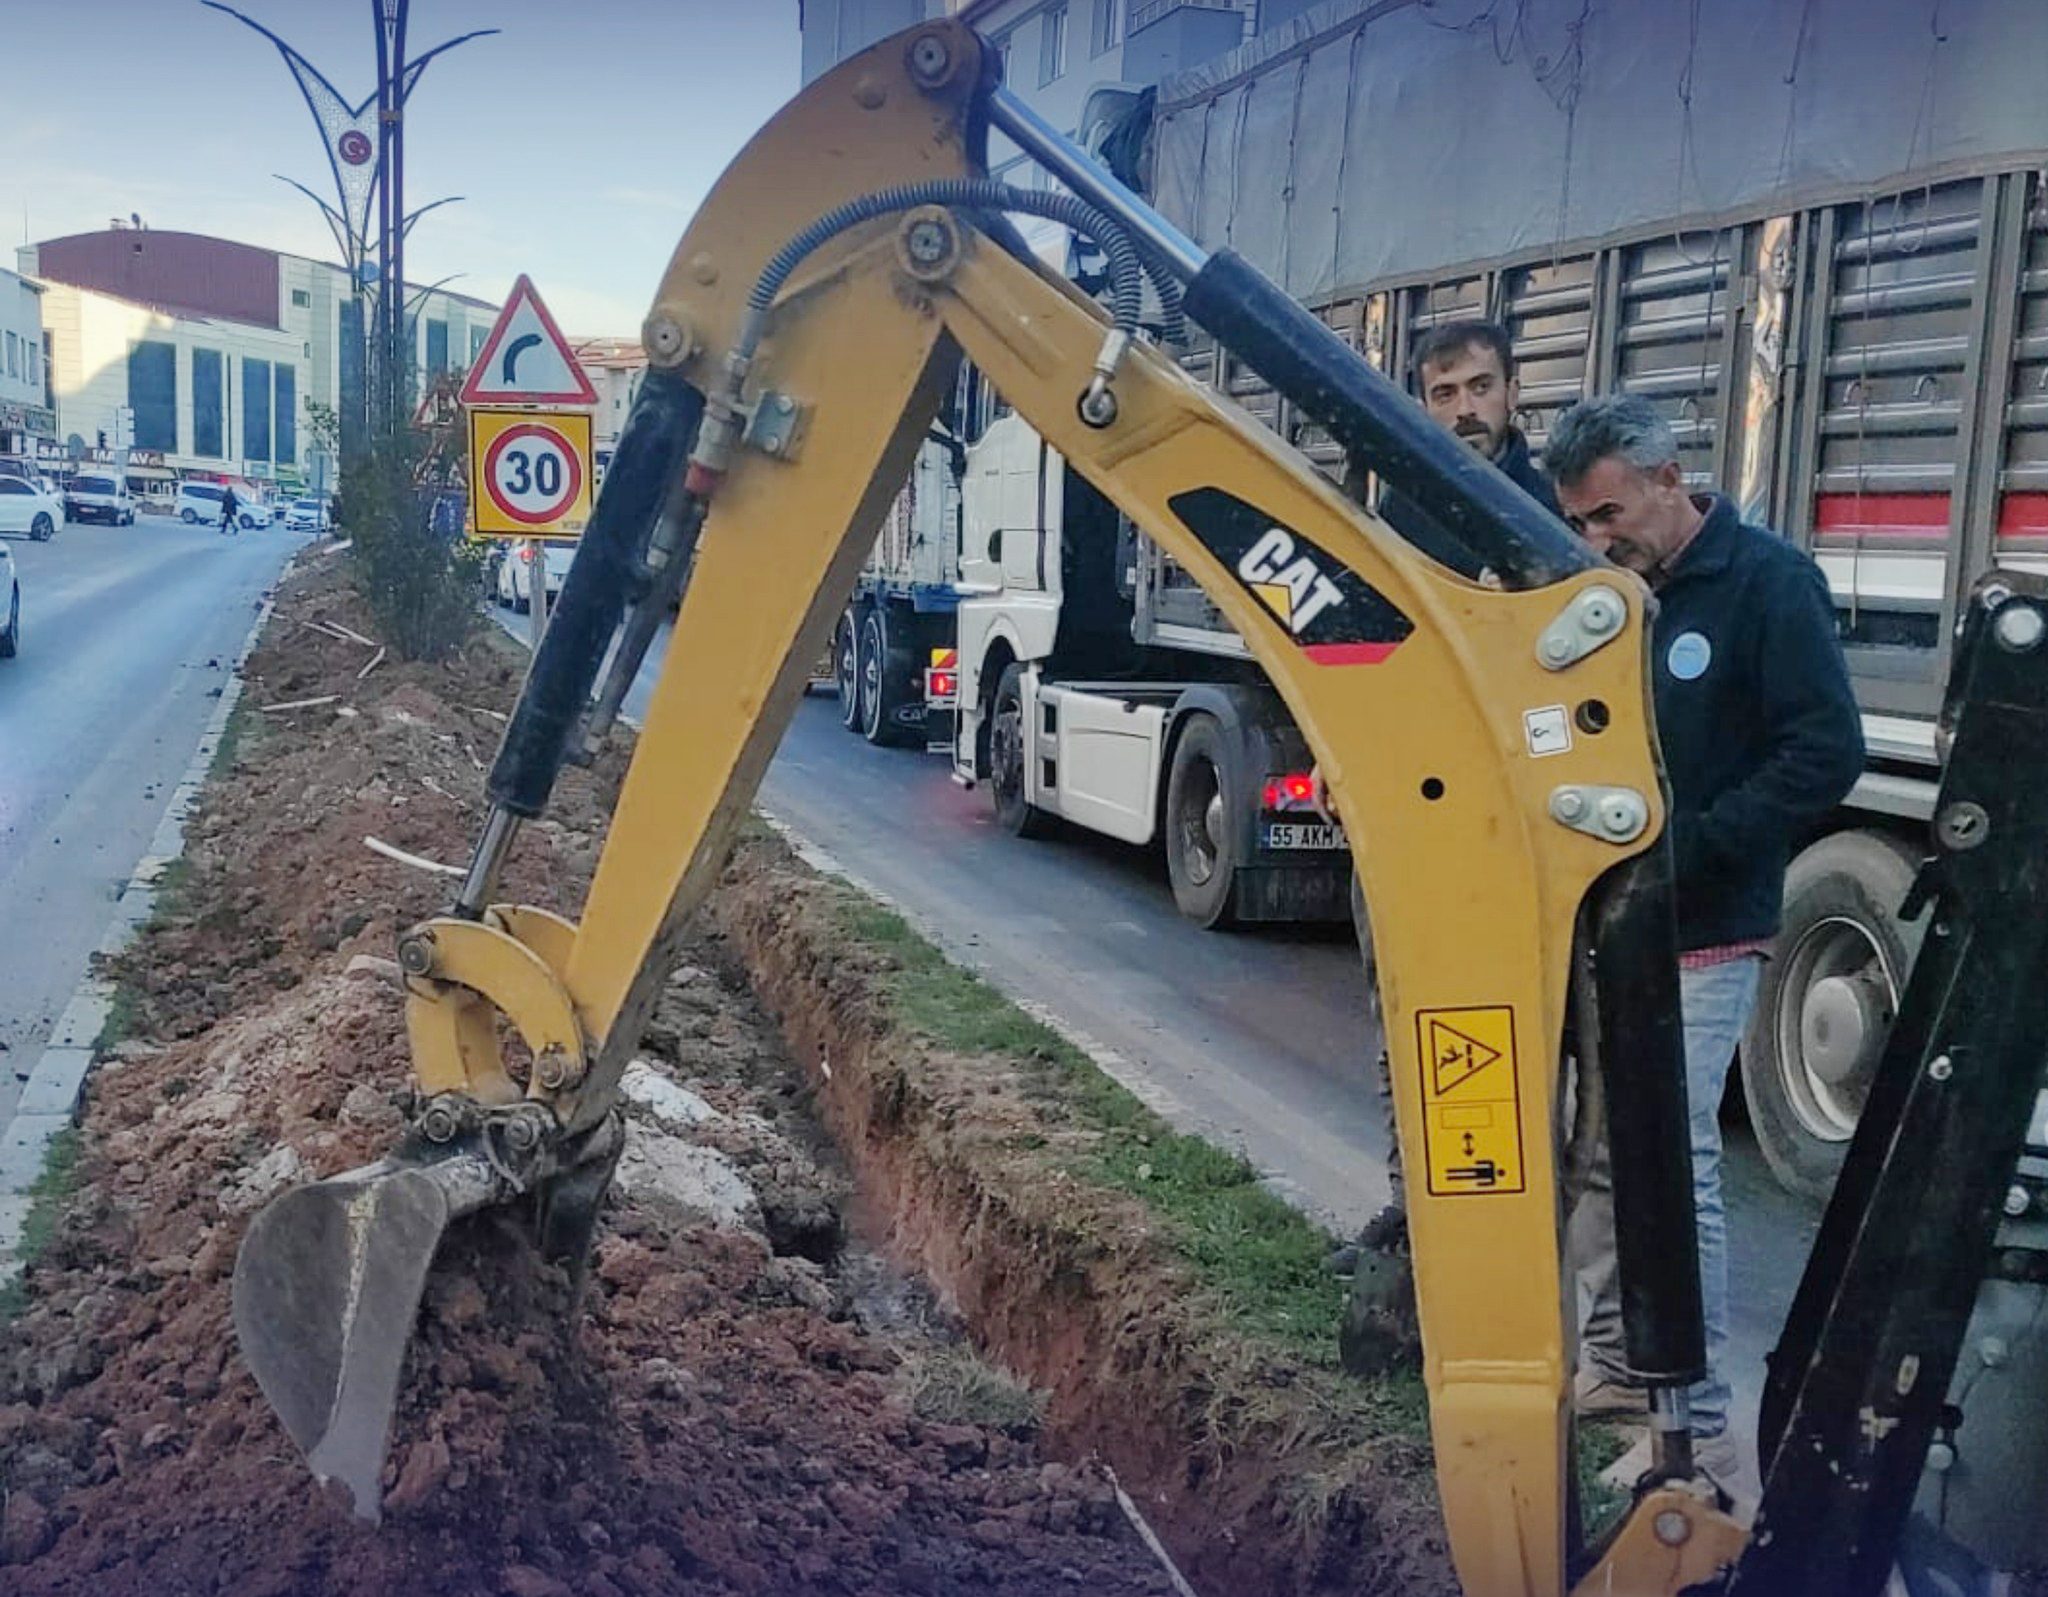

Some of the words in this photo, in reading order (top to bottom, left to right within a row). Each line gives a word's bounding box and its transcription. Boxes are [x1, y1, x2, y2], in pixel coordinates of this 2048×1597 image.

[92, 448, 149, 466] MAAV
[504, 450, 561, 497] 30
[1238, 528, 1345, 635] CAT
[1271, 826, 1293, 846] 55
